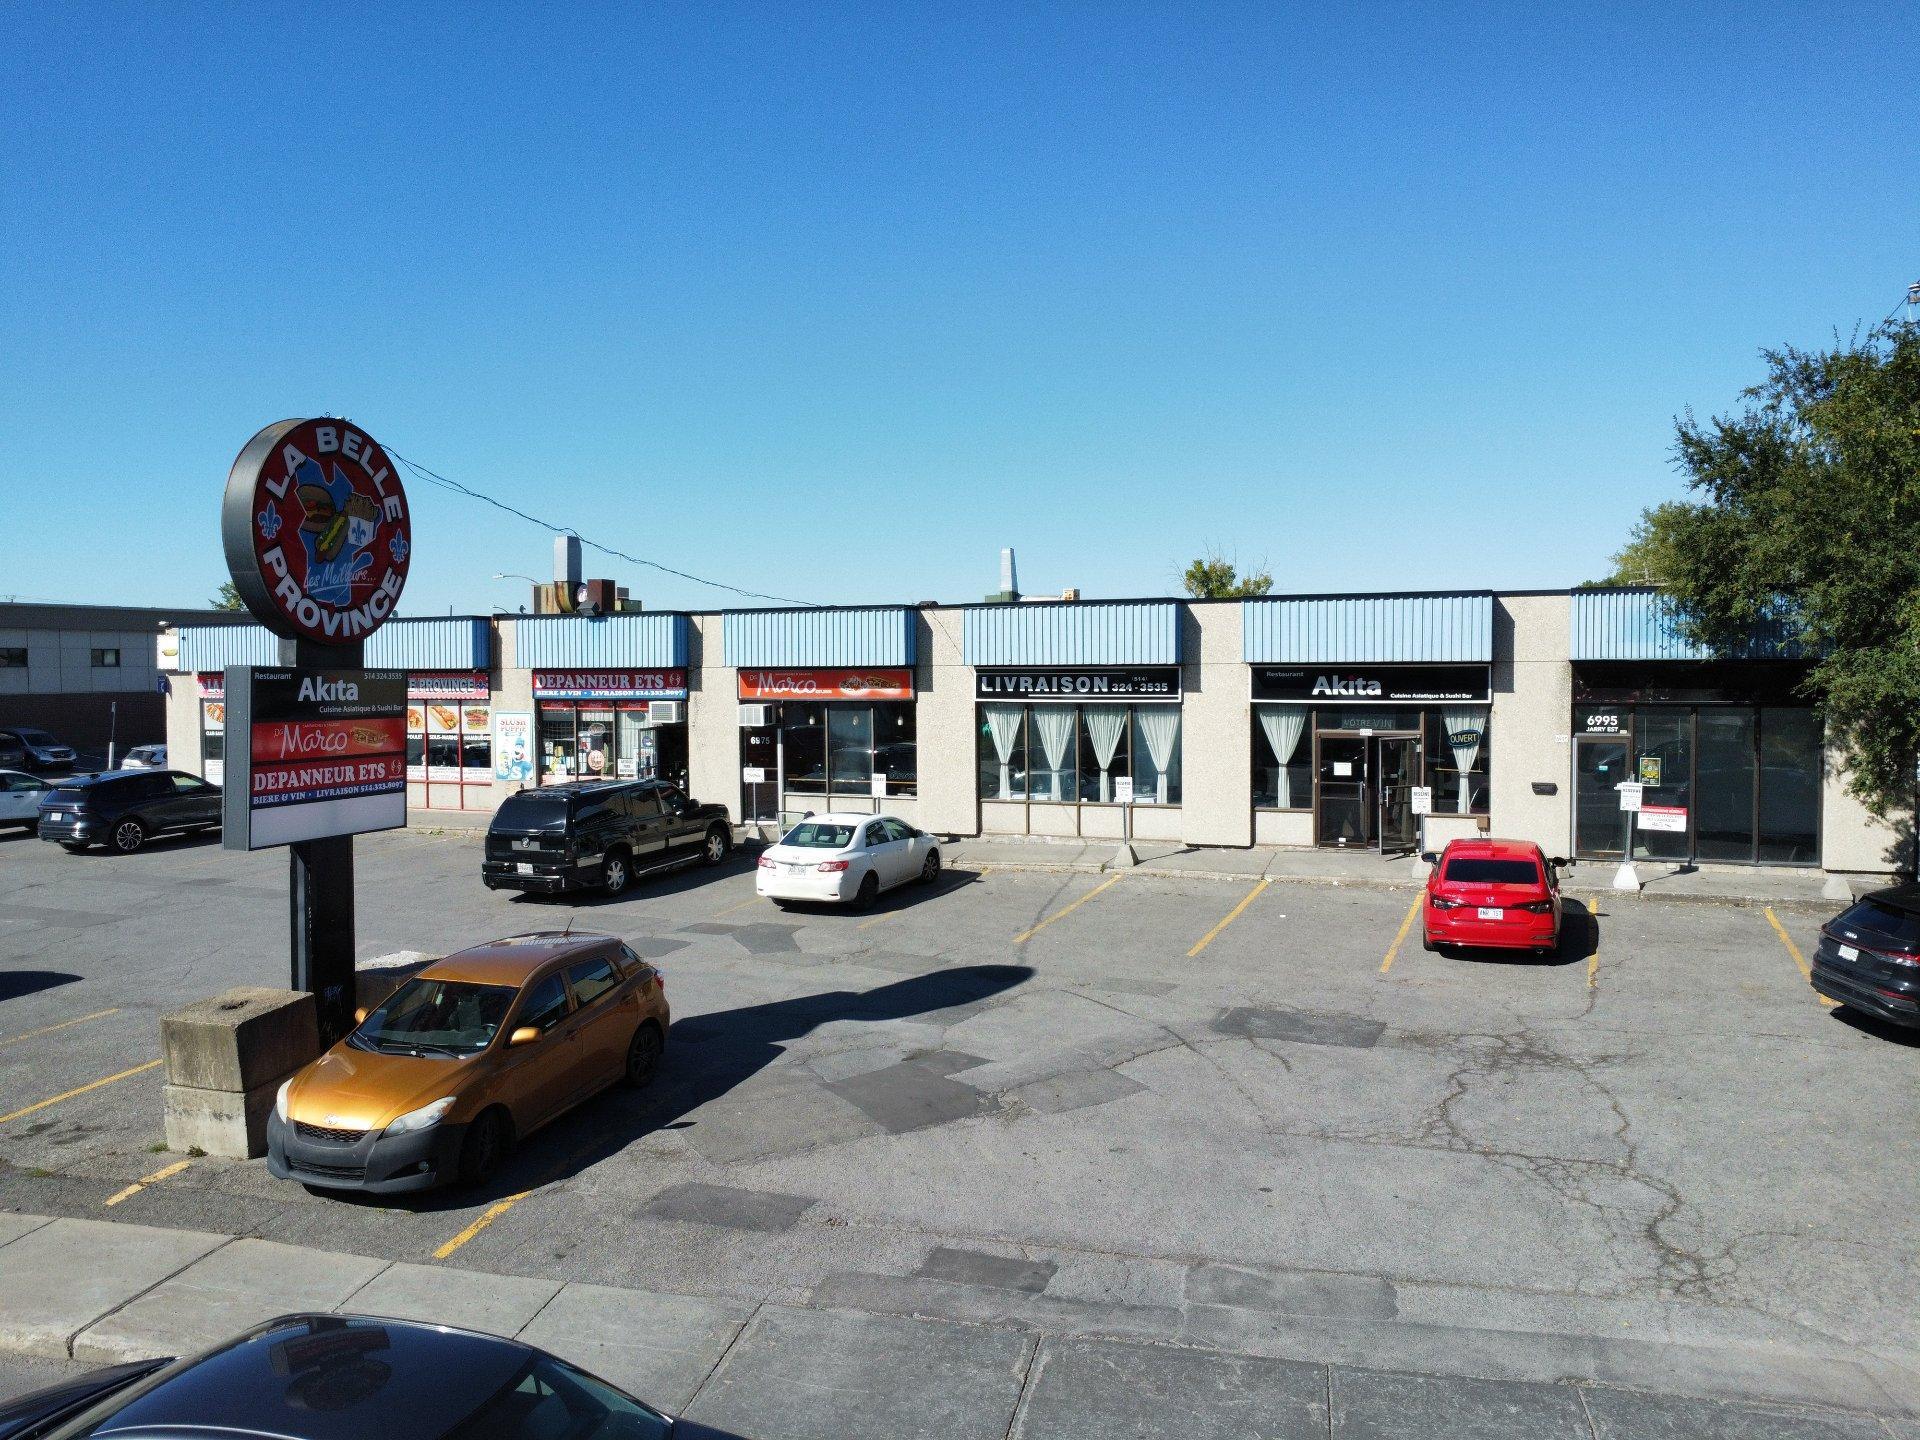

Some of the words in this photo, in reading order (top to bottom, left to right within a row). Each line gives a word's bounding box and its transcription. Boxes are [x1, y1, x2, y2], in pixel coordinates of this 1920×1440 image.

[265, 443, 308, 500] LA
[315, 426, 403, 524] BELLE
[303, 570, 319, 589] Les
[262, 545, 403, 638] PROVINCE
[254, 671, 292, 681] Restaurant
[418, 677, 476, 694] PROVINCE
[536, 674, 631, 689] DEPANNEUR
[634, 674, 664, 689] ETS
[757, 672, 817, 697] Marco
[981, 676, 1109, 692] LIVRAISON
[1311, 675, 1382, 696] Akita
[297, 675, 359, 702] Akita
[319, 705, 342, 714] Cuisine
[343, 704, 371, 715] Asiatique
[371, 704, 377, 712] &
[377, 703, 393, 712] Sushi
[393, 703, 404, 711] Bar
[1586, 715, 1619, 726] 6995
[280, 723, 349, 759] Marco
[750, 736, 771, 745] 6975
[1450, 733, 1478, 744] OUVERT
[253, 764, 356, 792] DEPANNEUR
[358, 762, 386, 781] ETS
[253, 794, 280, 805] BIERE
[281, 793, 288, 802] &
[290, 791, 306, 801] VIN
[316, 785, 359, 798] LIVRAISON
